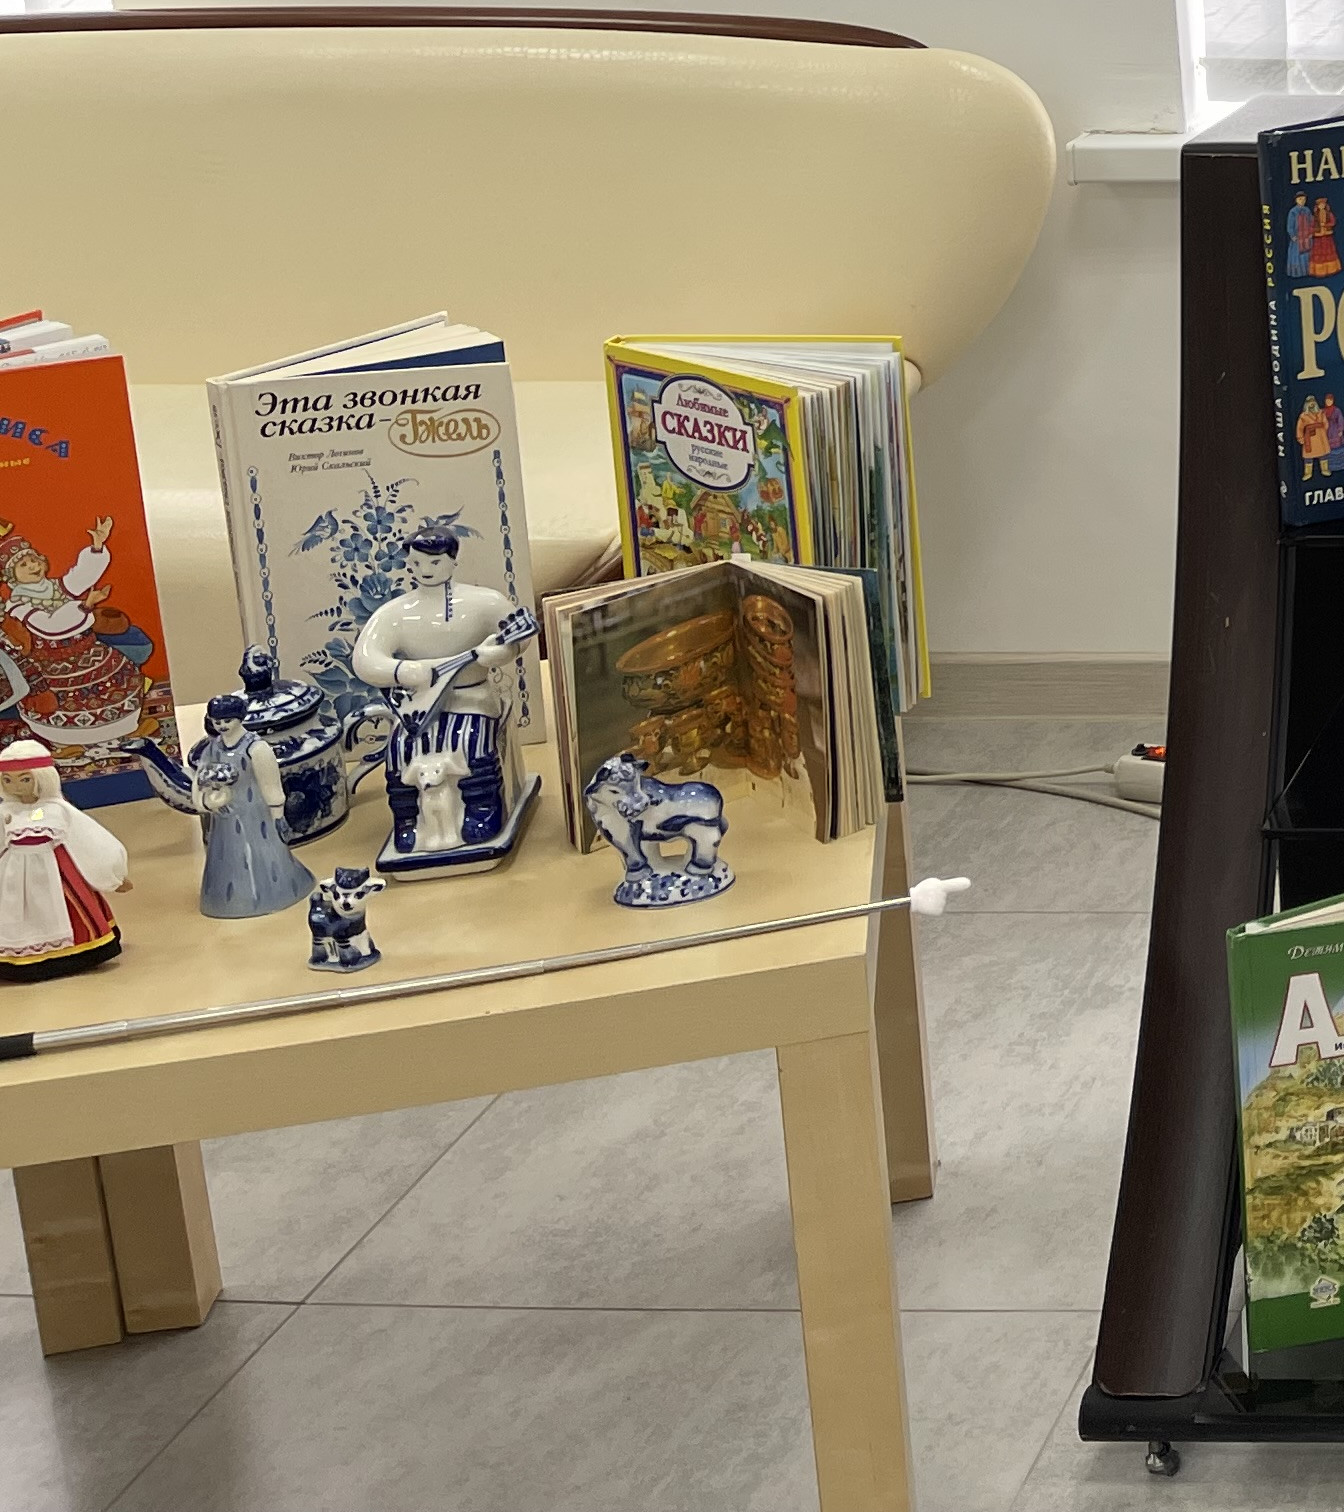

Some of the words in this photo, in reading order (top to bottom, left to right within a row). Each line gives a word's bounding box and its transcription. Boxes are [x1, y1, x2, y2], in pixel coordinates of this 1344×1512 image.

[1262, 204, 1275, 287] РОССИЯ
[1268, 300, 1282, 386] РОДИНА
[255, 391, 333, 417] Эта
[342, 382, 482, 410] звонкая
[676, 393, 729, 418] Любимые
[395, 408, 491, 445] Гжель
[661, 410, 750, 453] СКАЗКИ
[1274, 398, 1286, 457] НАША
[290, 462, 318, 473] Юрий
